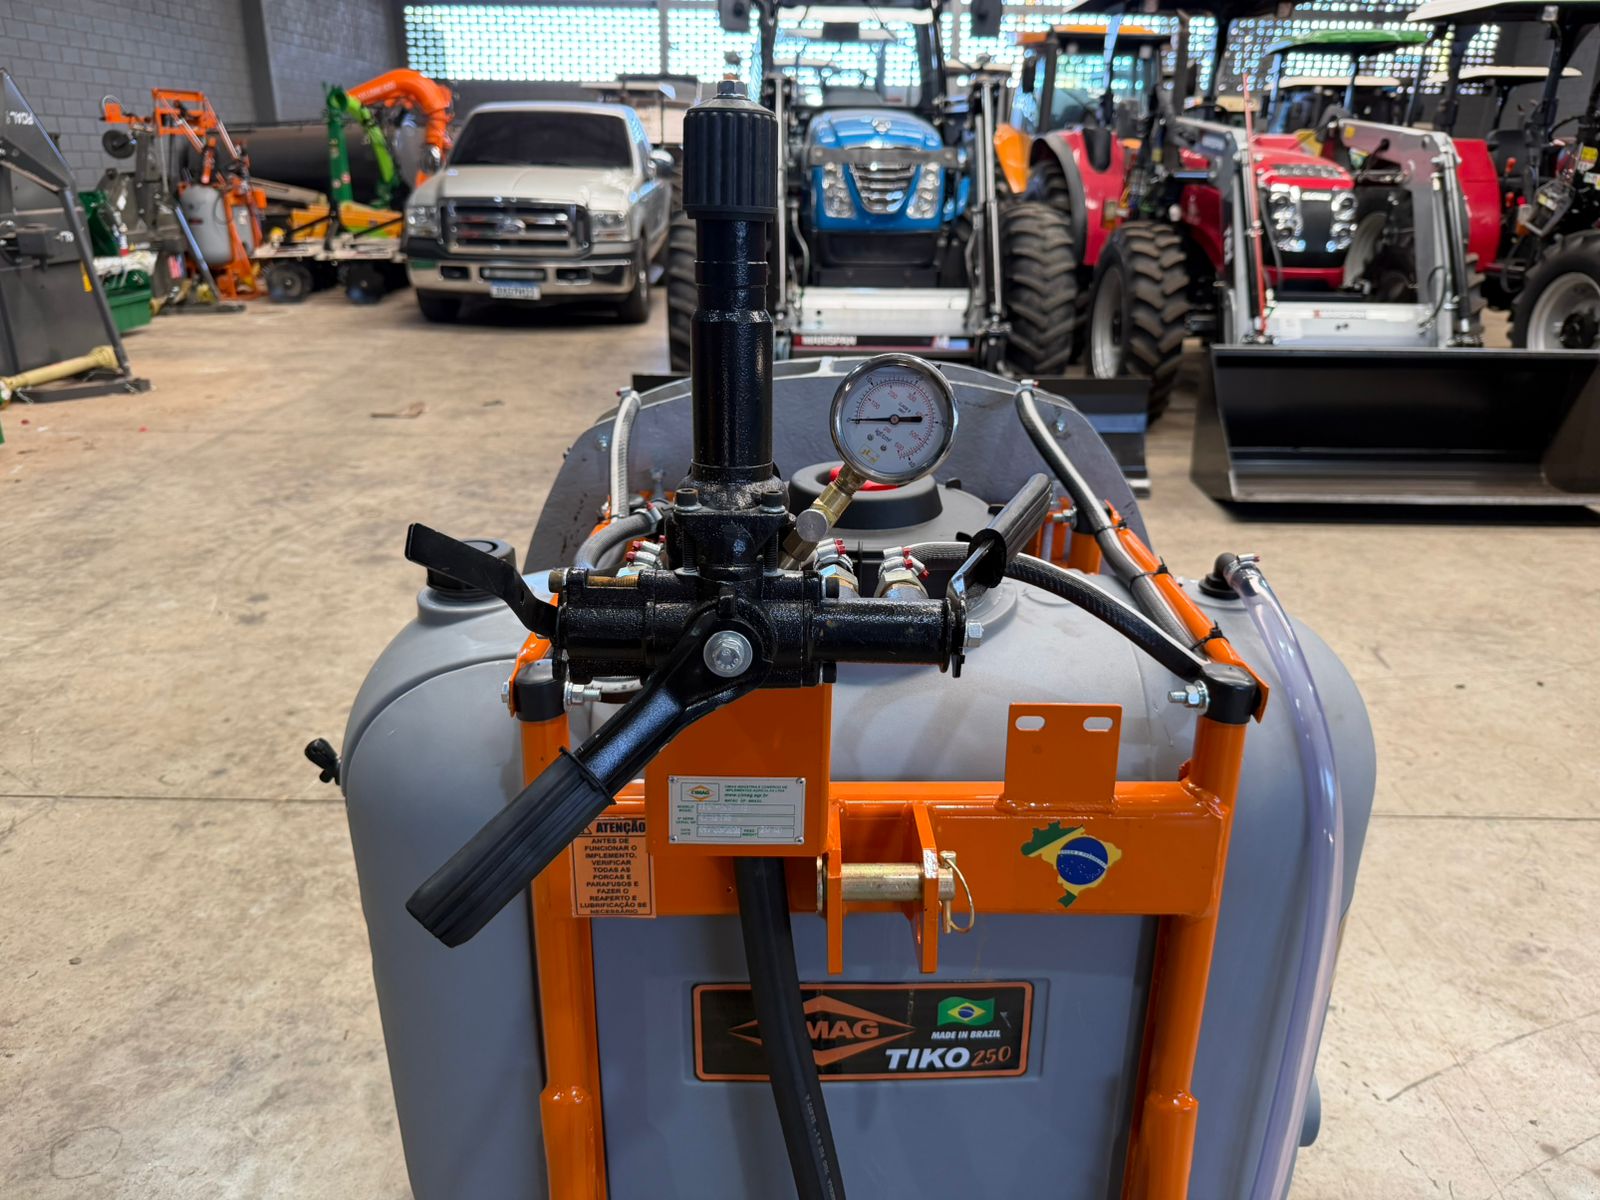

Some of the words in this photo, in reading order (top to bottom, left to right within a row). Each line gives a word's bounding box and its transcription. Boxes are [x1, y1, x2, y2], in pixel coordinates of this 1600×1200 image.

[596, 820, 646, 834] ATENÇÃO
[580, 901, 636, 909] LUBRIFICAÇÃO
[806, 1020, 879, 1040] MAG
[931, 1030, 956, 1040] MADE
[958, 1030, 968, 1039] IN
[970, 1029, 1001, 1039] BRAZIL
[885, 1047, 970, 1070] TIKO
[971, 1045, 1011, 1067] 250
